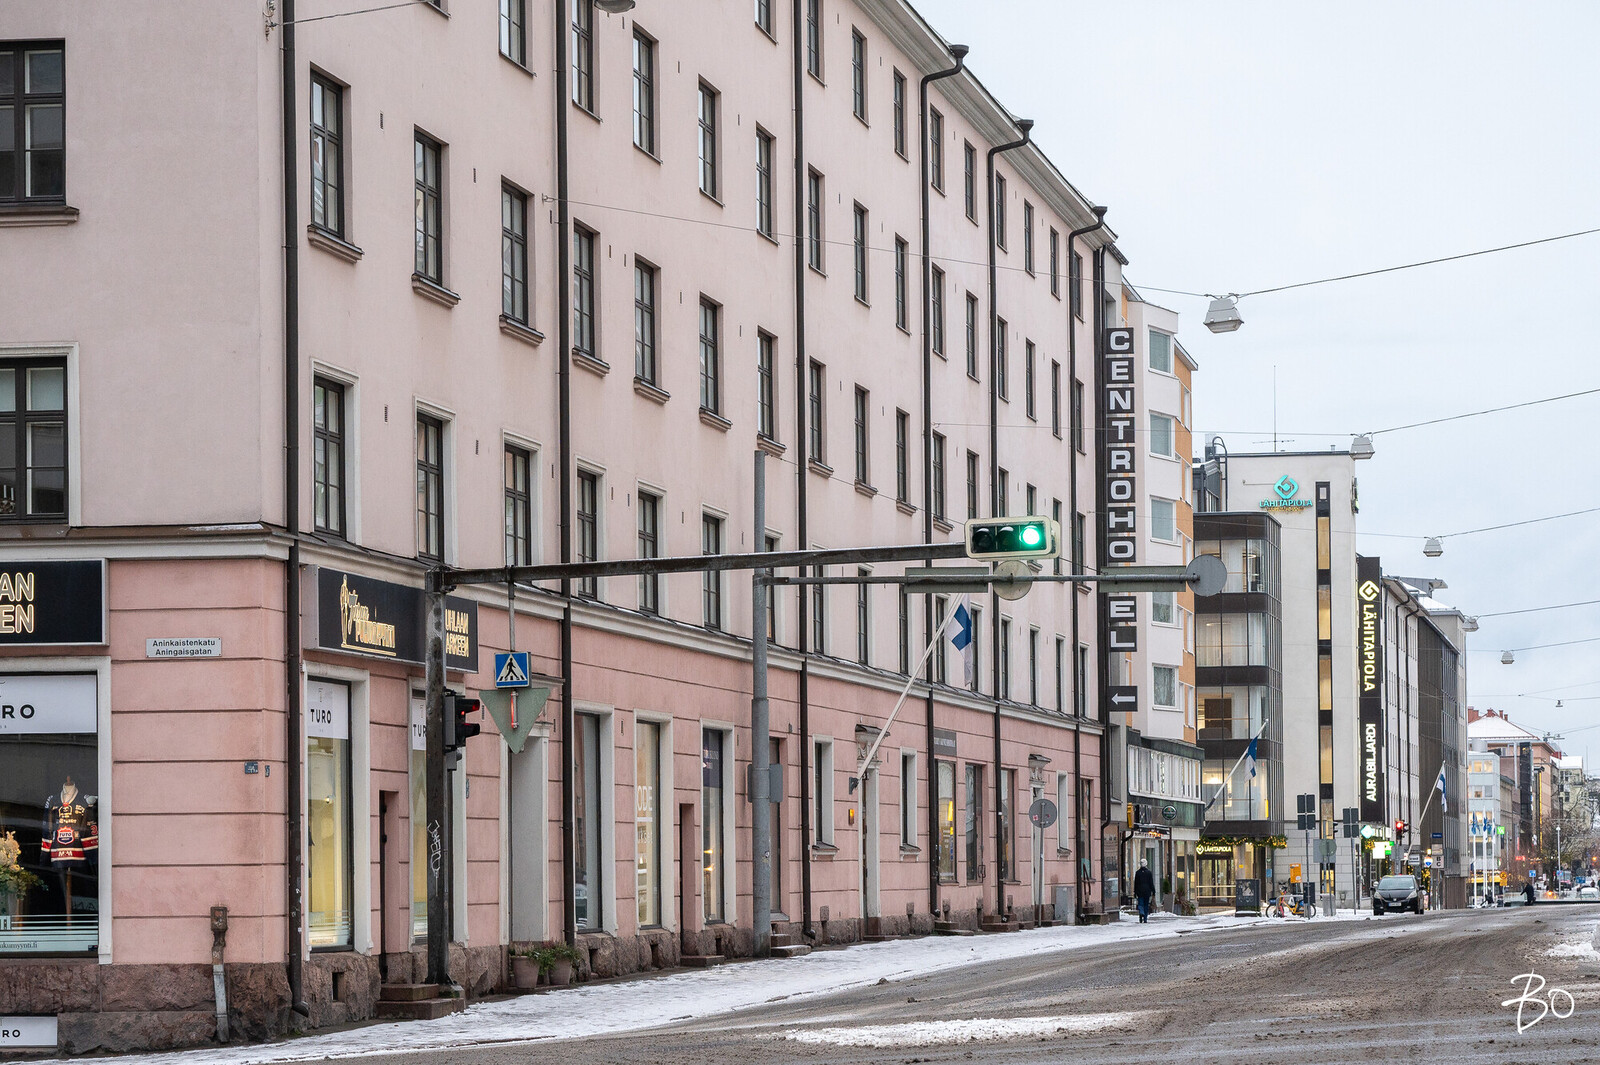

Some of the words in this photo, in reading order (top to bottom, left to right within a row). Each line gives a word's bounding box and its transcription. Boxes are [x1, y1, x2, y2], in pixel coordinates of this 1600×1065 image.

[1108, 330, 1136, 649] CENTROHOEL
[1259, 497, 1313, 508] LÄHITAPIOLA
[445, 608, 469, 635] UHLAAN
[152, 639, 216, 648] Aninkaistenkatu
[1363, 604, 1378, 692] LÄHITAPIOLA
[155, 648, 212, 657] Aningaisgatan
[1, 704, 36, 720] RO
[310, 708, 332, 725] TURO
[412, 724, 427, 738] TUR
[1365, 723, 1378, 803] AURABILJARDI
[2, 1029, 21, 1038] RO
